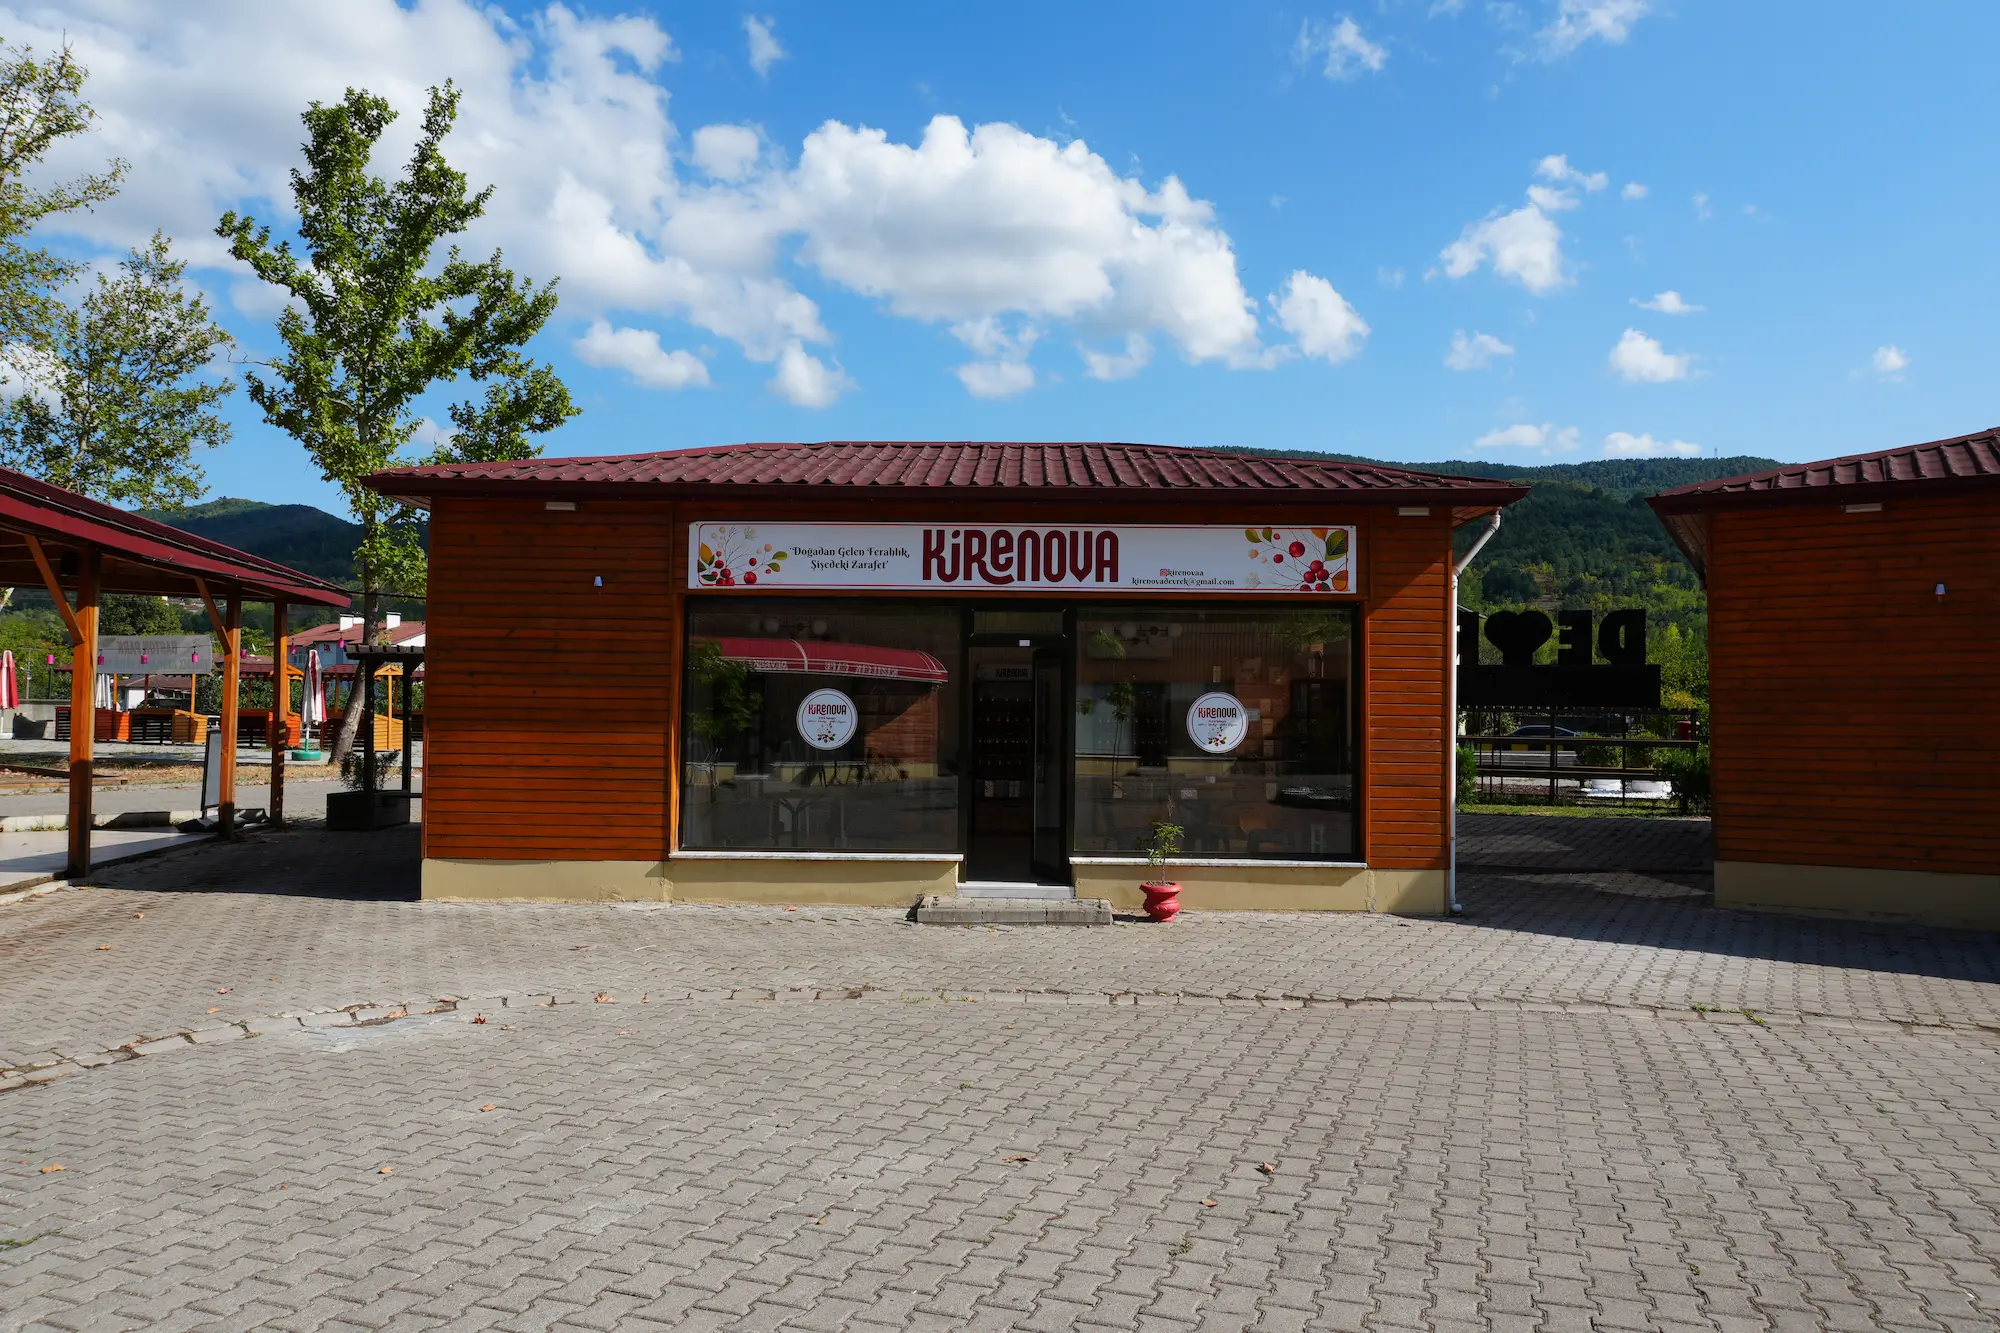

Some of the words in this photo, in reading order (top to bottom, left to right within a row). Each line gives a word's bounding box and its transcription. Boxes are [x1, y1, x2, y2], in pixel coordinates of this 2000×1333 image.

[838, 546, 865, 558] Gelen
[811, 560, 849, 571] Şişedeki
[1132, 577, 1235, 586] kirenovadevrek@gmail.com
